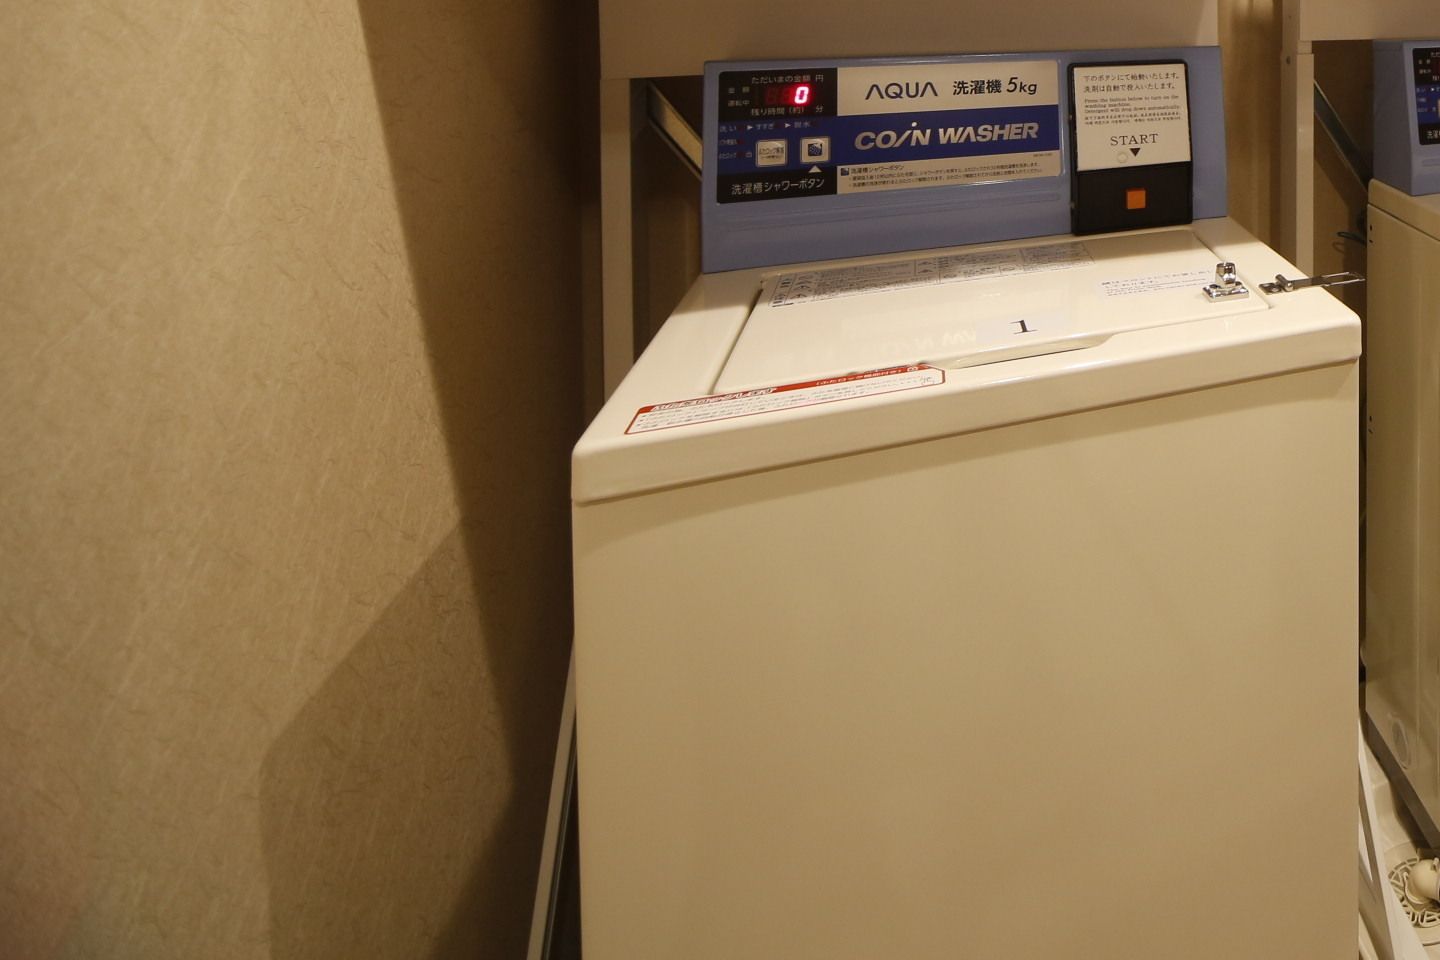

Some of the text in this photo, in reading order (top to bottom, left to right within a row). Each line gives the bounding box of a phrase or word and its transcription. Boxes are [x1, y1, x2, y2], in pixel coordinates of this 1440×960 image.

[751, 74, 824, 84] ただいまの金額 円
[865, 77, 1038, 101] AQUA 洗濯機 5kg
[1083, 82, 1175, 93] 洗剤は自動で投入いたします。
[794, 86, 810, 105] 0
[751, 107, 785, 116] 残り時間
[815, 105, 824, 113] 分
[938, 122, 1040, 145] WASHER
[1110, 133, 1159, 147] START
[731, 178, 825, 195] 洗濯槽シャワーボタン
[1008, 319, 1038, 334] 1
